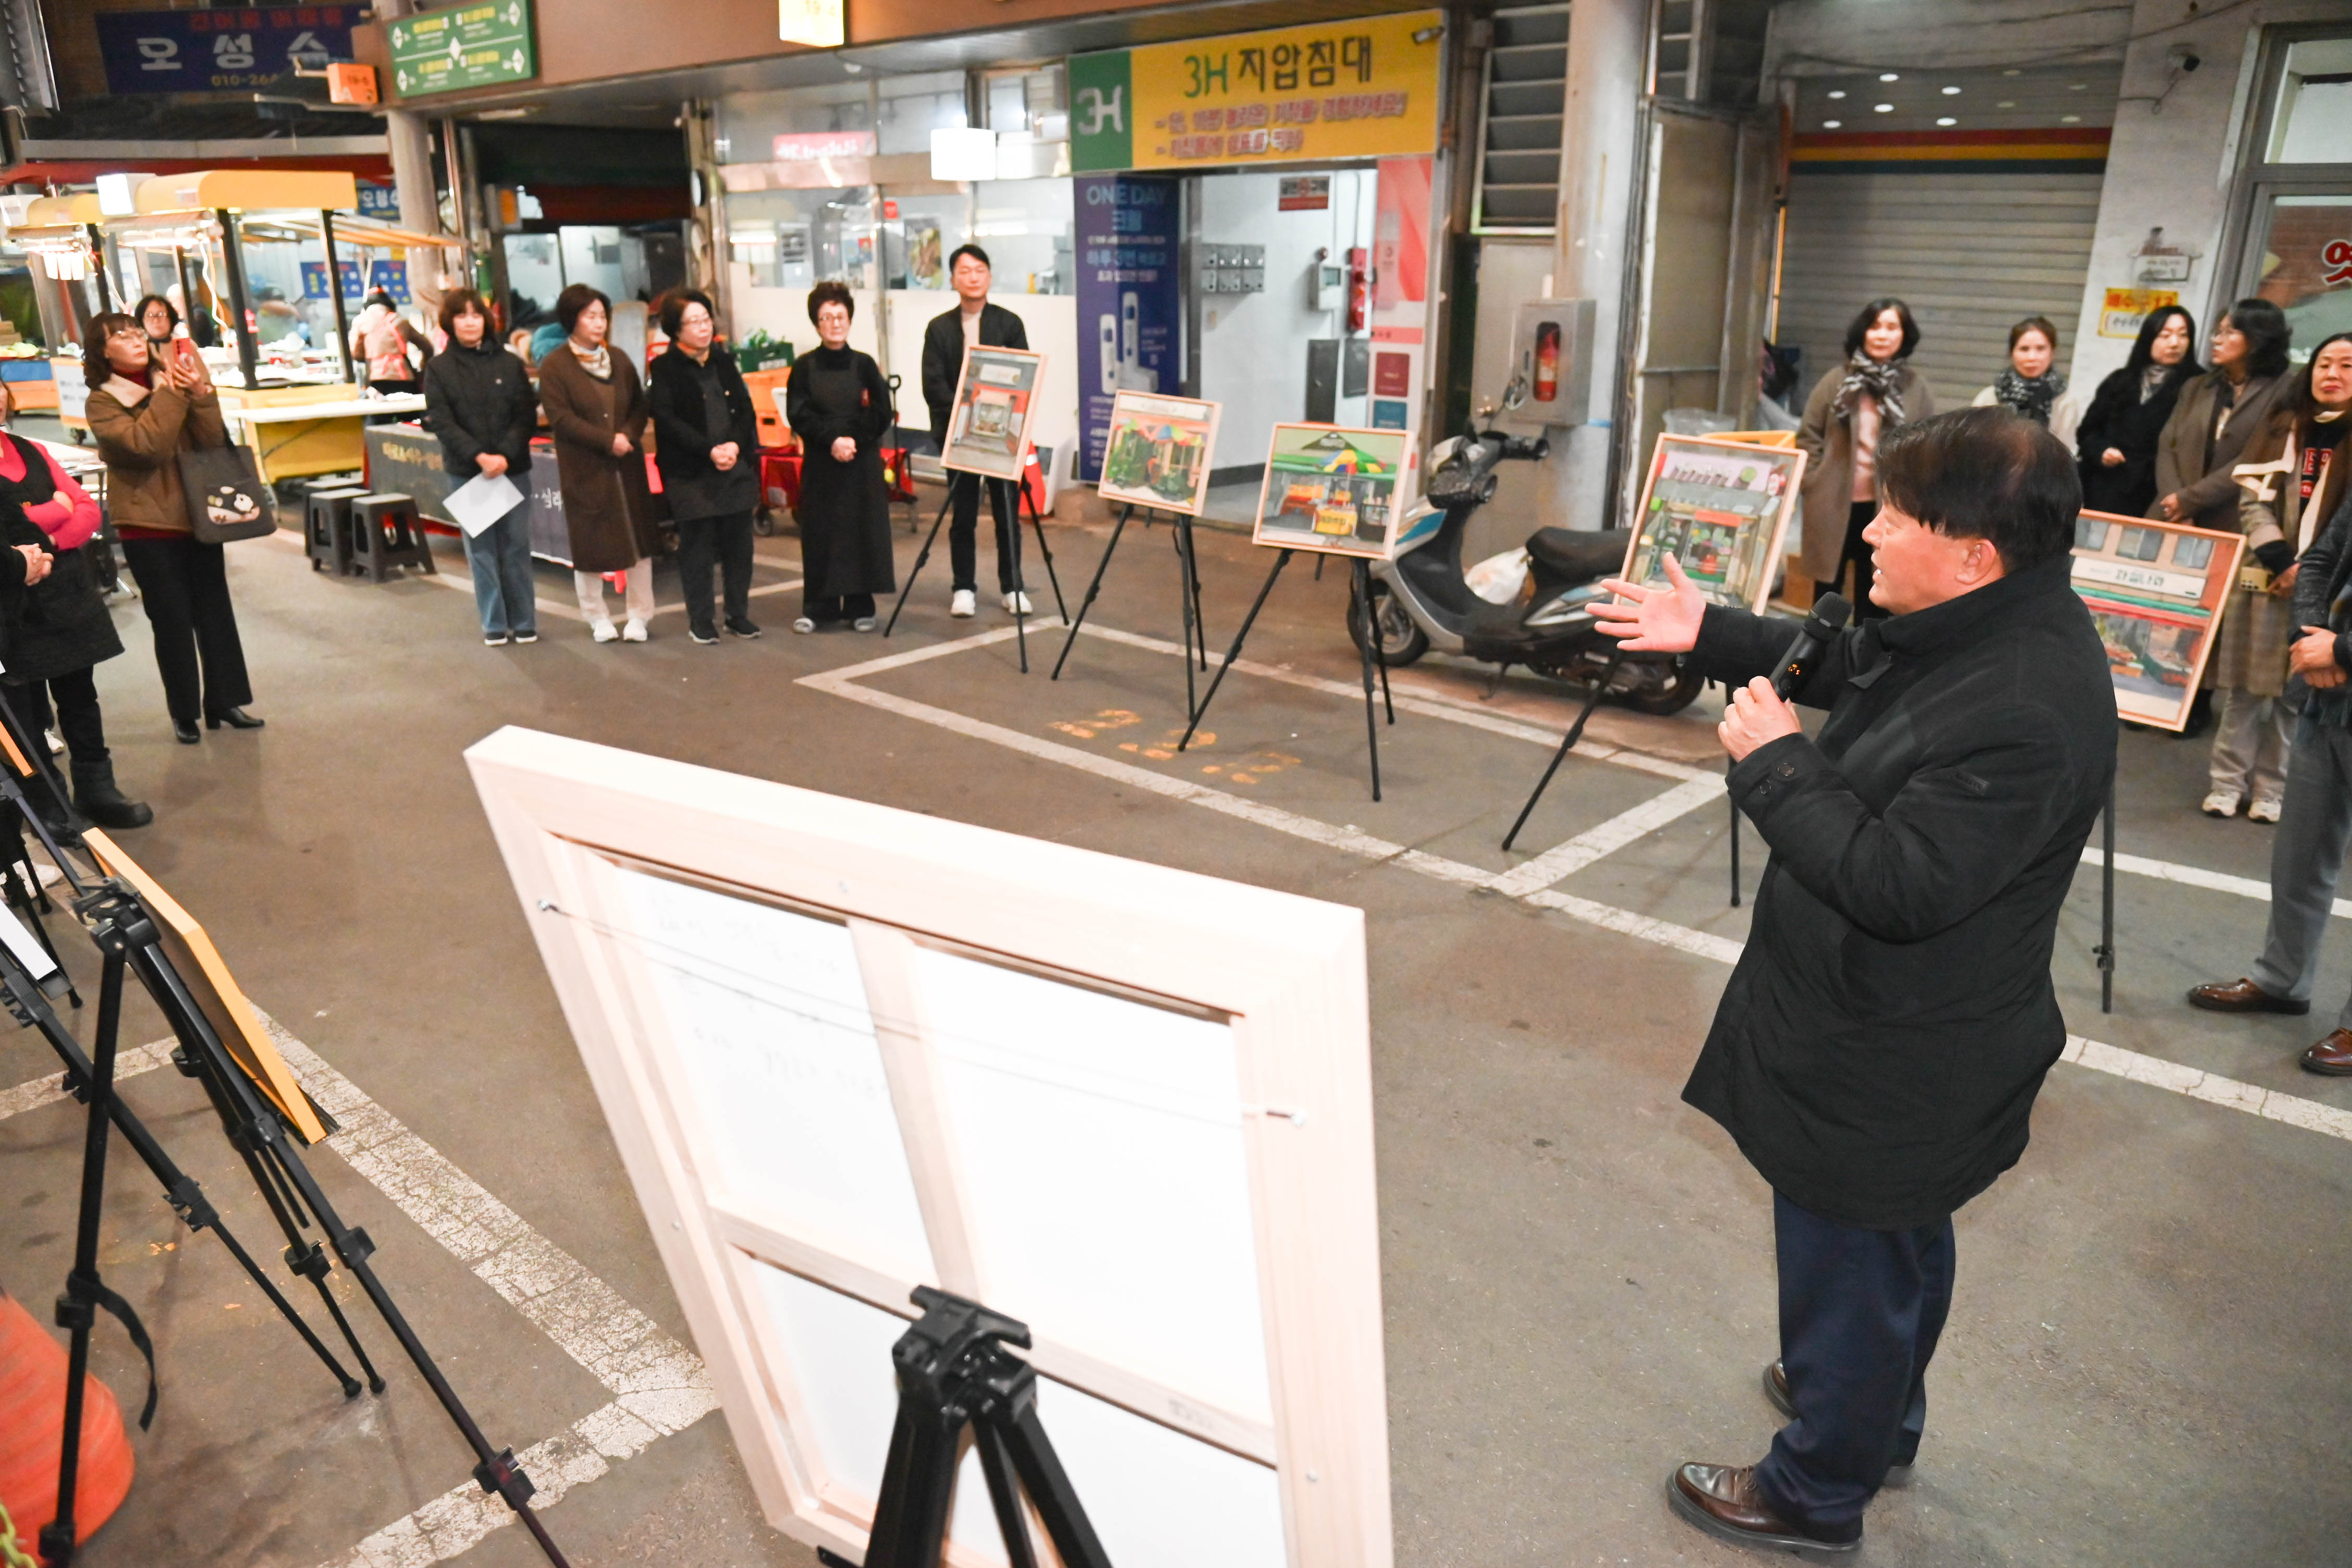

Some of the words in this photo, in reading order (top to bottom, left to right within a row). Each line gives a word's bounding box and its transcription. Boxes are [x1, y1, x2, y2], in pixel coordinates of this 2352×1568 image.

[1184, 54, 1228, 98] 3H
[1238, 35, 1371, 93] 지압침대
[1076, 84, 1123, 135] 3H
[1086, 185, 1128, 205] ONE
